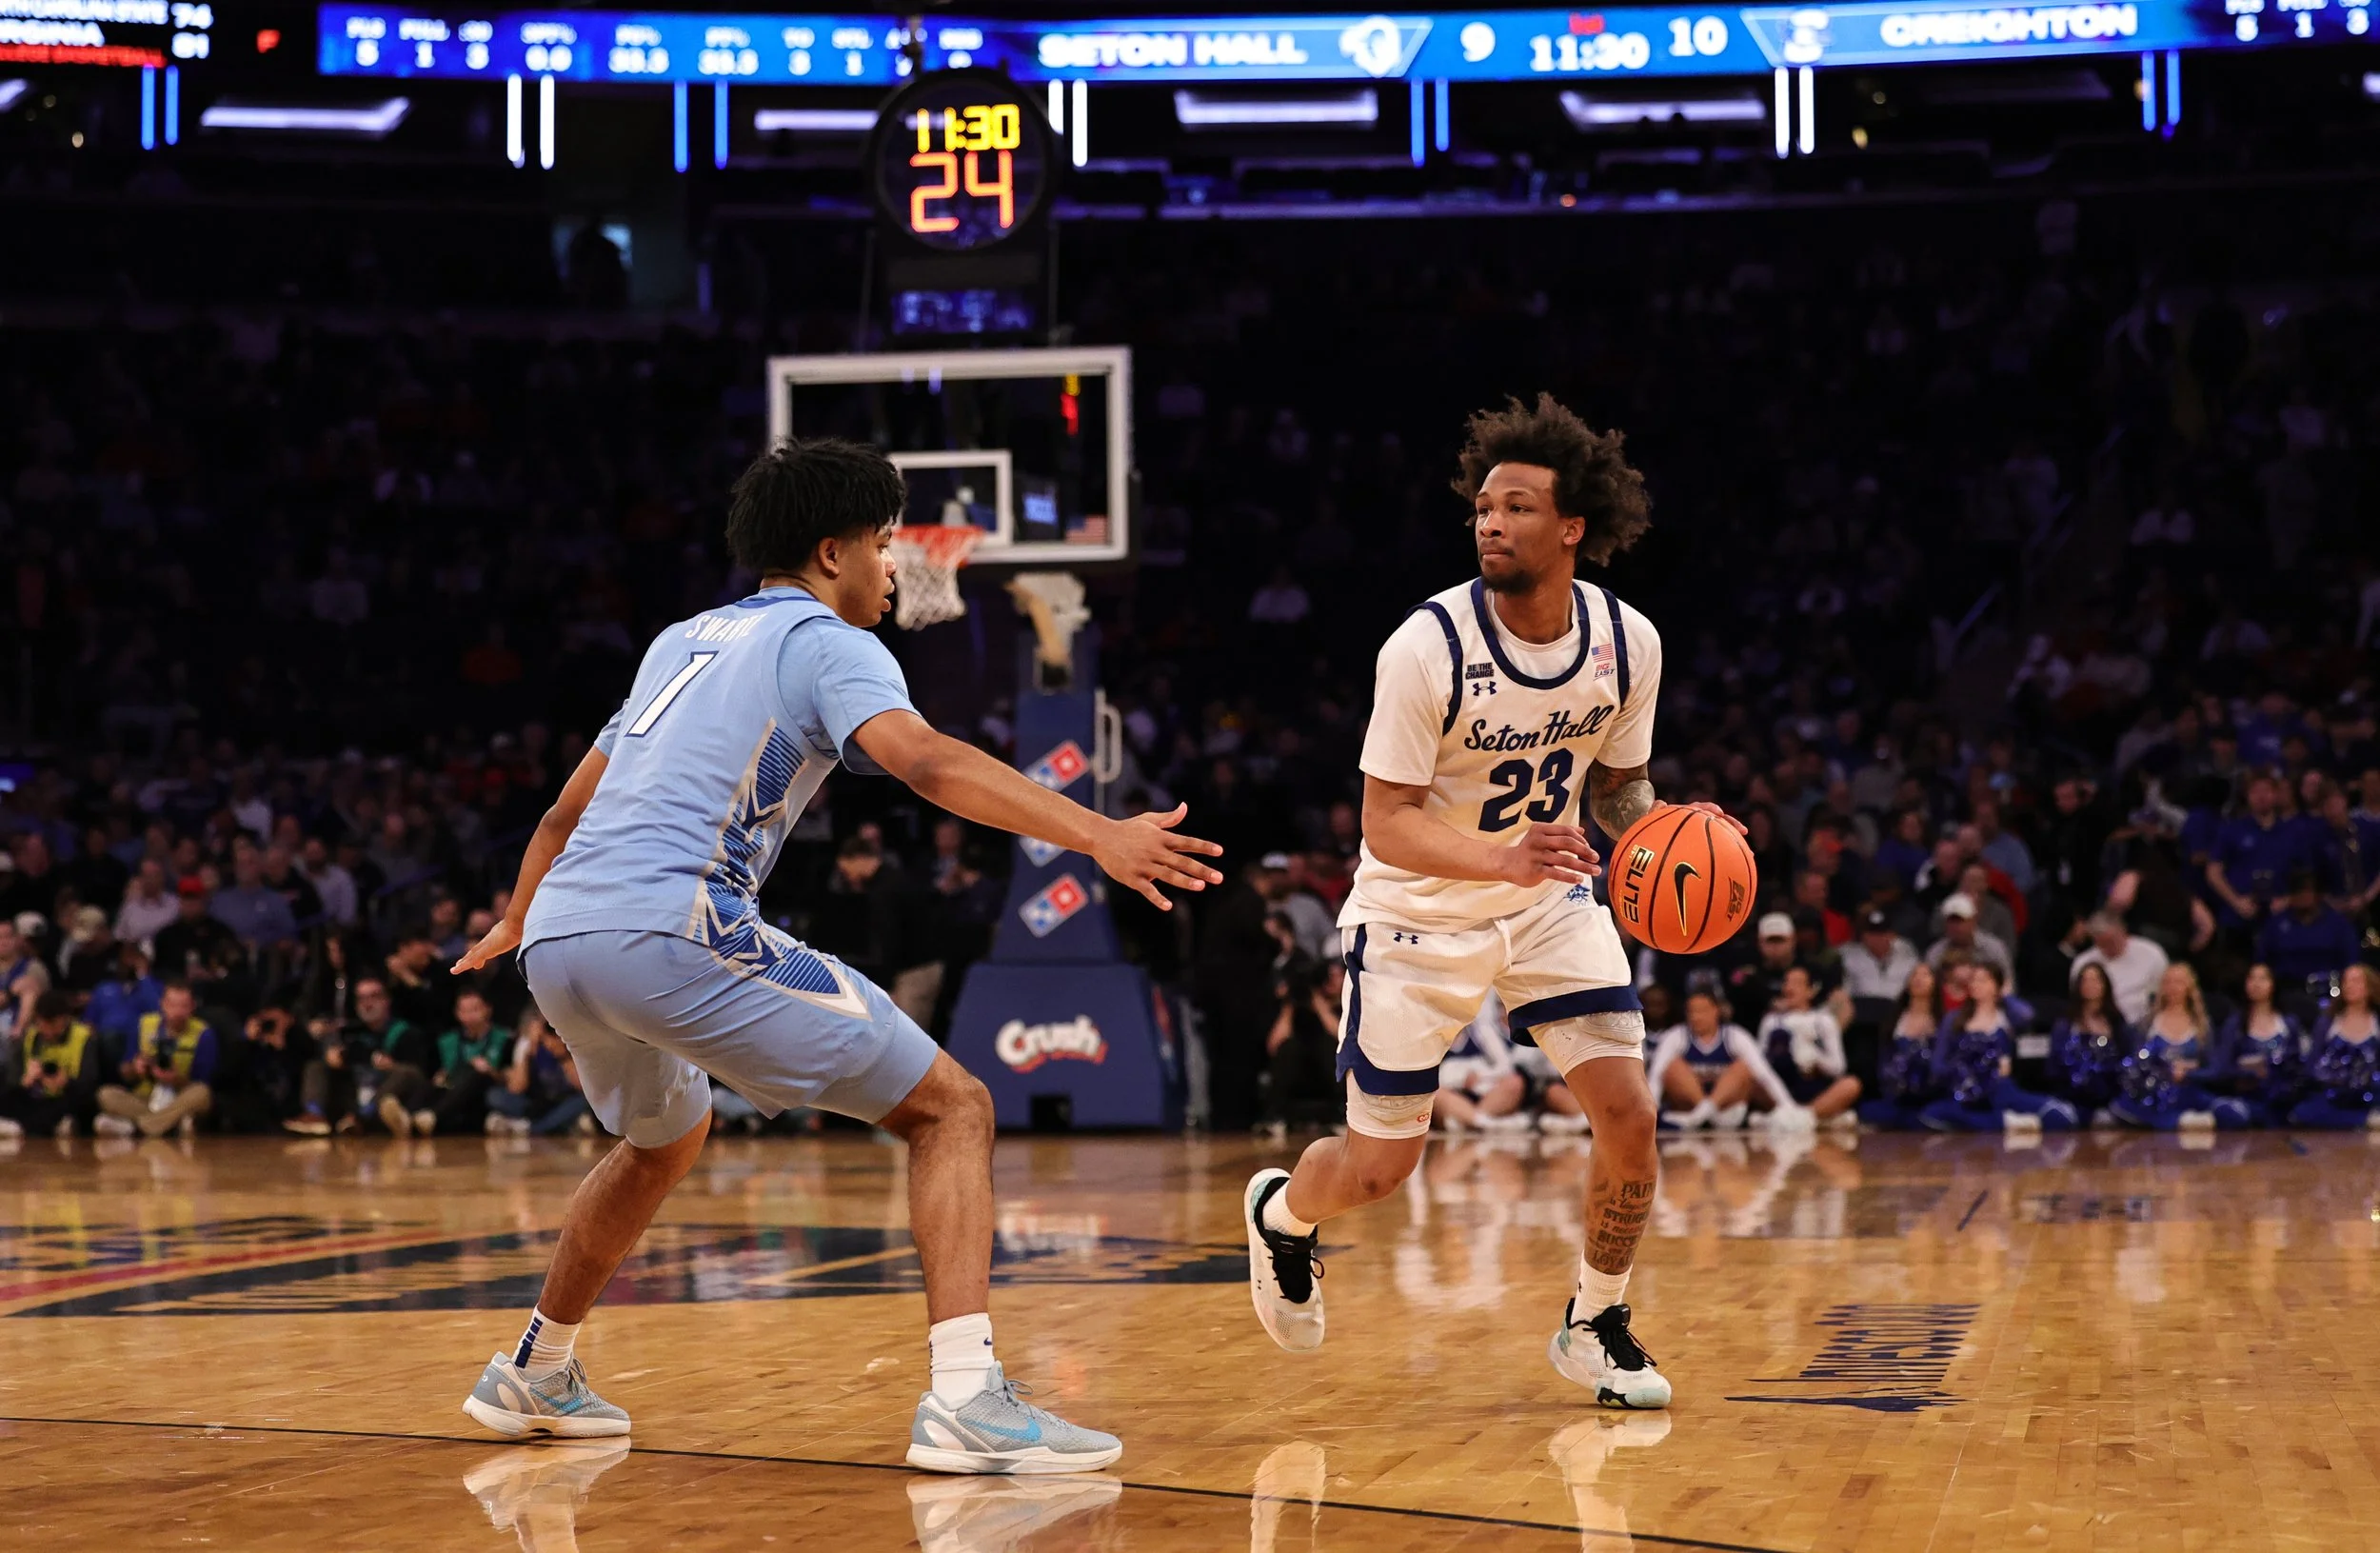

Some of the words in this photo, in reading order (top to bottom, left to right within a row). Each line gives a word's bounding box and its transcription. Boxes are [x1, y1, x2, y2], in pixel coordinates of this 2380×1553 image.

[1460, 21, 1496, 62] 9
[1668, 16, 1728, 57] 10
[1880, 4, 2138, 47] CREIGHTON
[1038, 33, 1188, 68] SETON
[1194, 32, 1309, 66] HALL
[1529, 31, 1651, 72] 11:30
[917, 103, 1021, 152] 11:30
[909, 149, 1015, 232] 24
[1465, 669, 1495, 680] CHANGE
[1467, 664, 1478, 672] BE
[1478, 662, 1493, 671] THE
[1594, 668, 1616, 678] EAST
[1596, 663, 1611, 671] BIG
[624, 650, 720, 738] 1
[1463, 719, 1544, 752] Seton
[1540, 705, 1615, 746] Hall
[1478, 747, 1575, 832] 23
[1622, 846, 1656, 925] ELITE
[1727, 880, 1740, 922] EAST
[995, 1013, 1106, 1070] Crush
[1813, 1304, 1981, 1326] QQQ
[1742, 1329, 1969, 1383] Invesco
